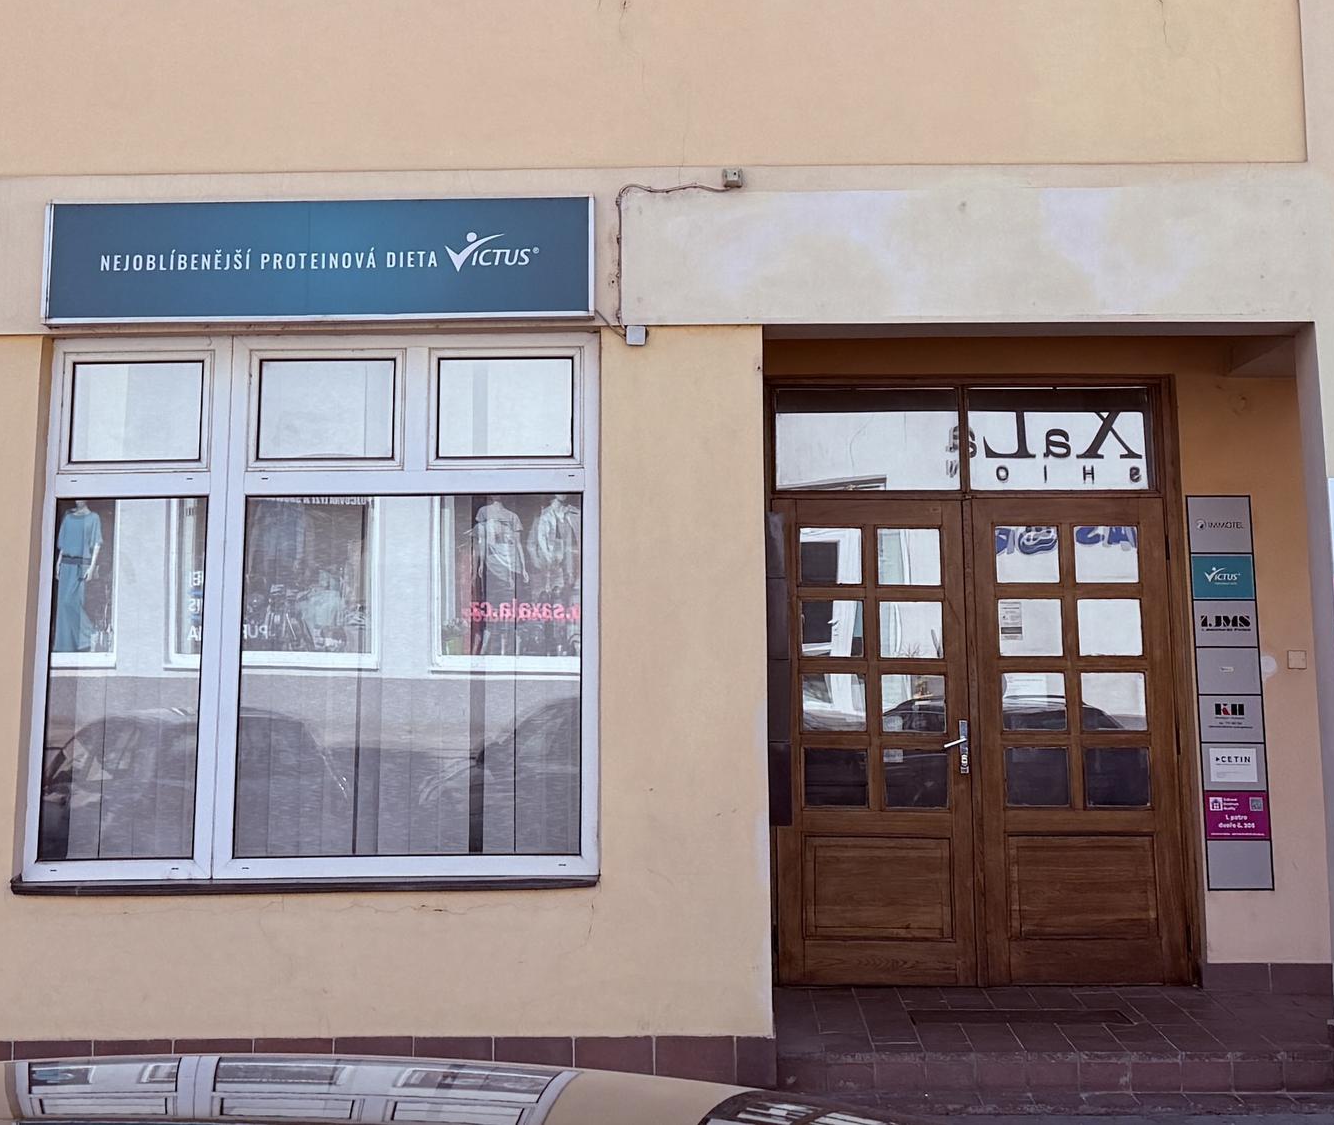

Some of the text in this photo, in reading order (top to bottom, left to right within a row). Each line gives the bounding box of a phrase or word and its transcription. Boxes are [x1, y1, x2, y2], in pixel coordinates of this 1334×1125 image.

[100, 248, 252, 272] NEJOBLÍBENĚJŠÍ
[260, 247, 378, 270] PROTEINOVÁ
[386, 250, 439, 268] DIETA
